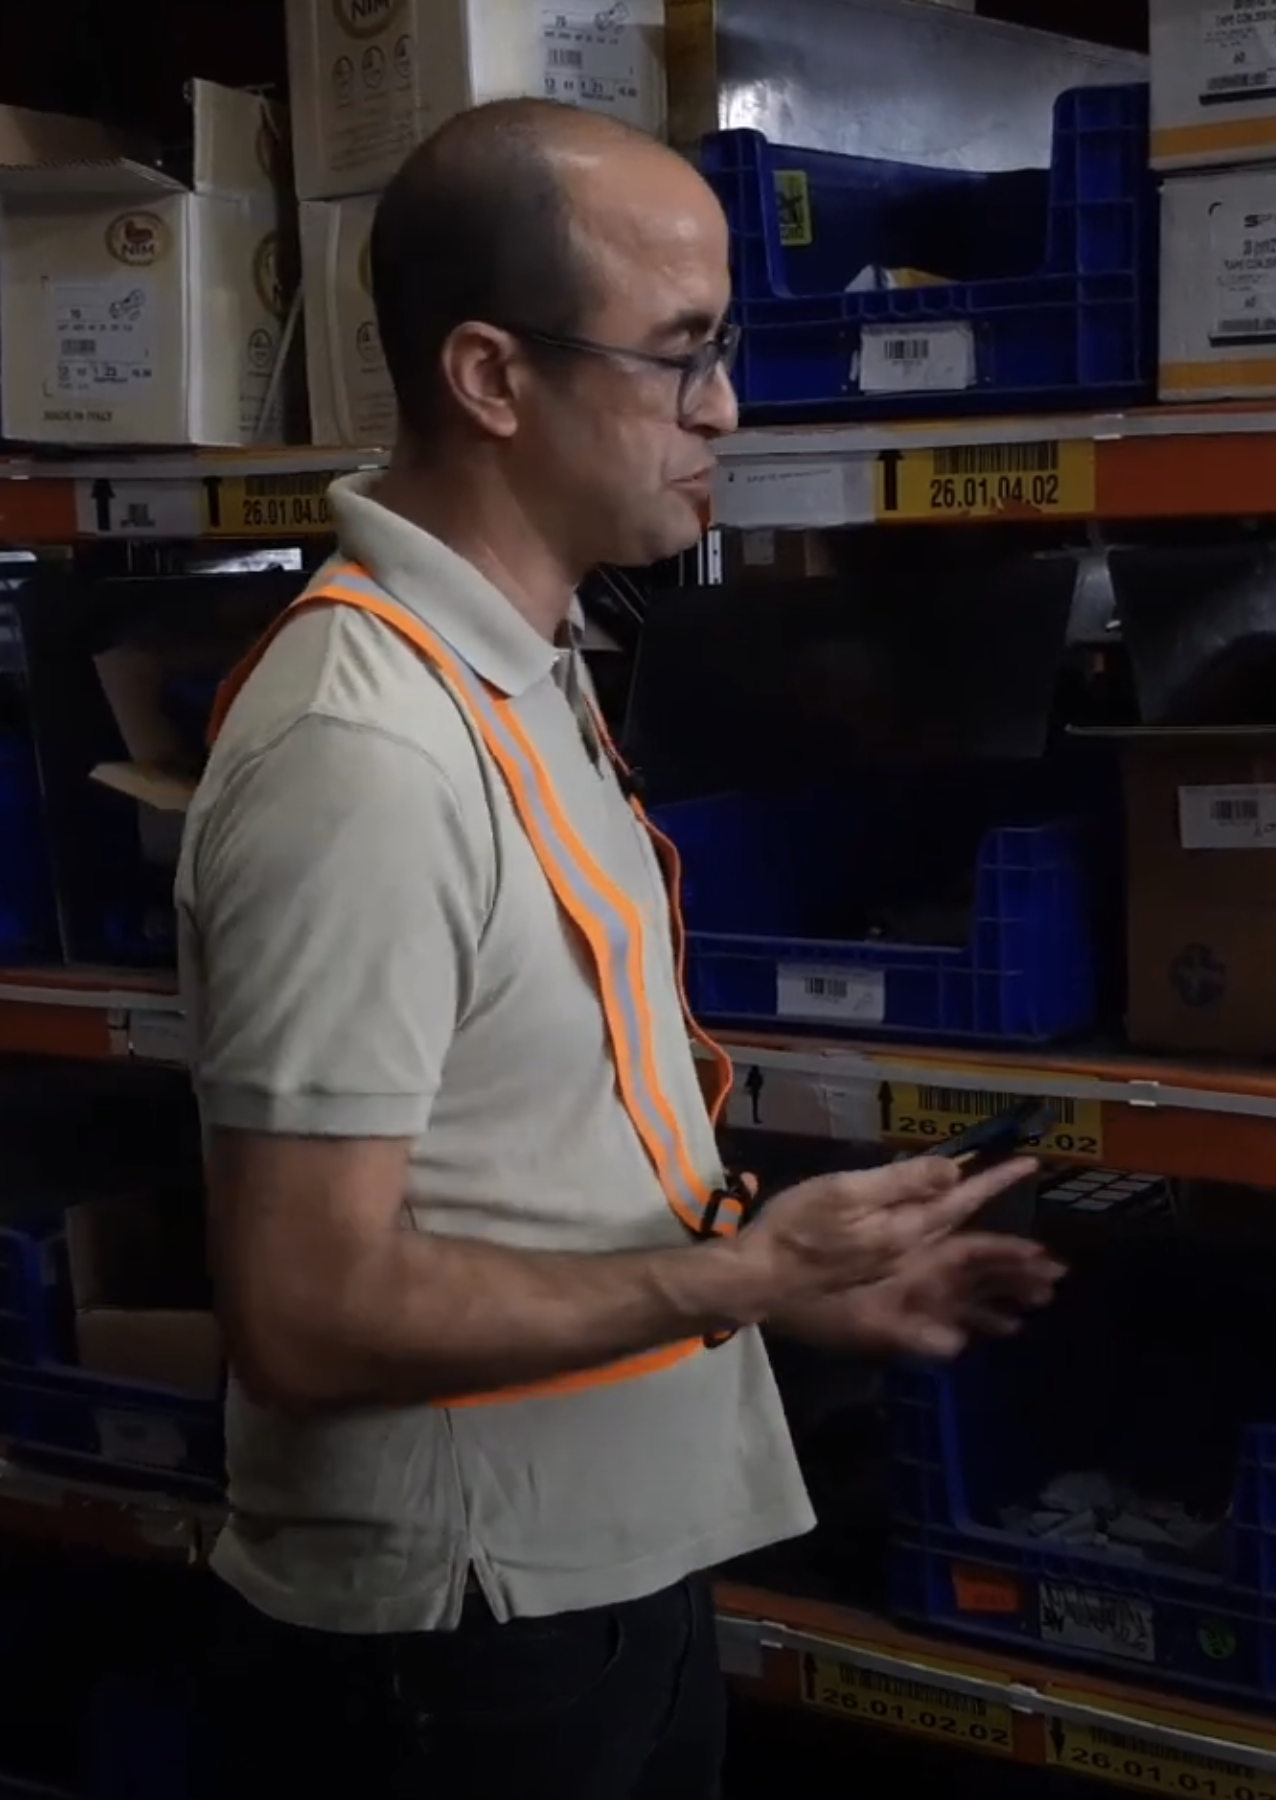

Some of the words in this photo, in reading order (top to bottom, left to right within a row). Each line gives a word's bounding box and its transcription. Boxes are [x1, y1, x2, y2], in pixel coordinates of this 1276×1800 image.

[122, 243, 156, 256] NIM
[930, 474, 1061, 509] 26.01.04.02
[243, 498, 332, 526] 26.01.04.0
[821, 1687, 1011, 1746] 26.01.02.02
